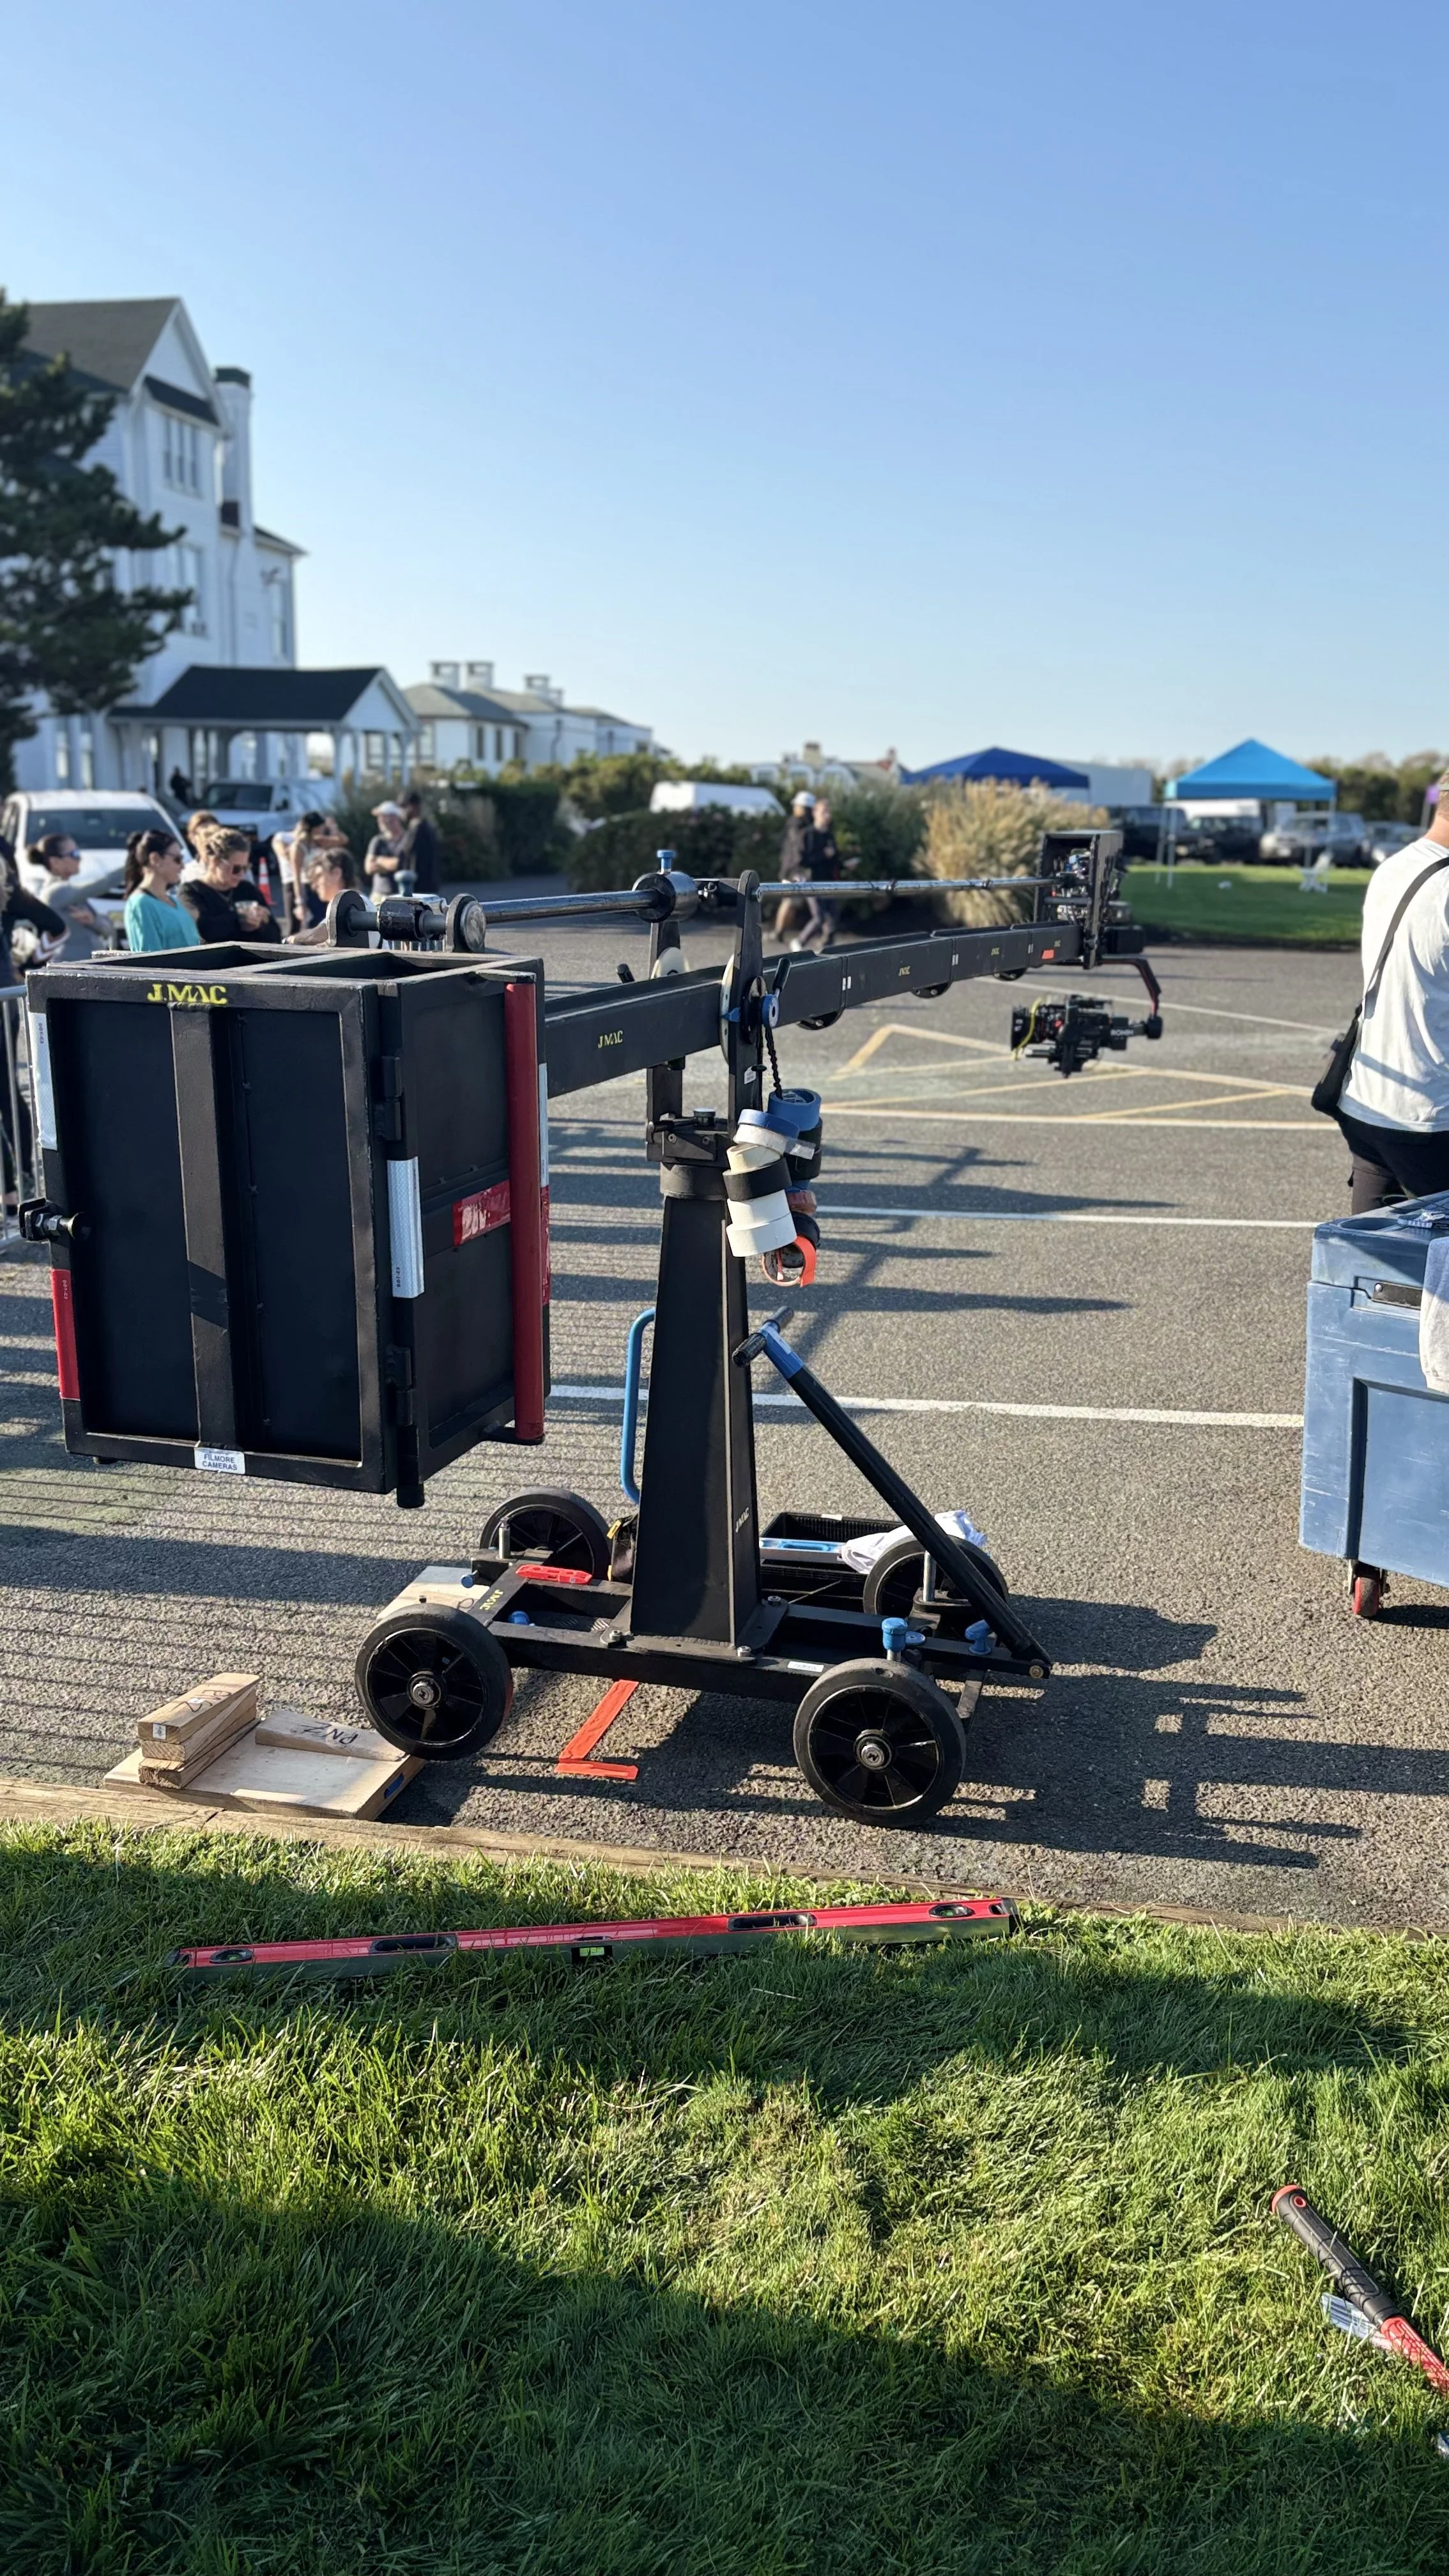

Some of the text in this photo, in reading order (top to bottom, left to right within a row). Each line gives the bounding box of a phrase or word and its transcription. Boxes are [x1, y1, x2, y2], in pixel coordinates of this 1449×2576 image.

[147, 984, 227, 1004] J.MAC
[597, 1030, 624, 1048] JMAC
[202, 1460, 238, 1471] CAMERAS
[204, 1453, 235, 1463] FILMORE
[735, 1507, 749, 1533] JMAC
